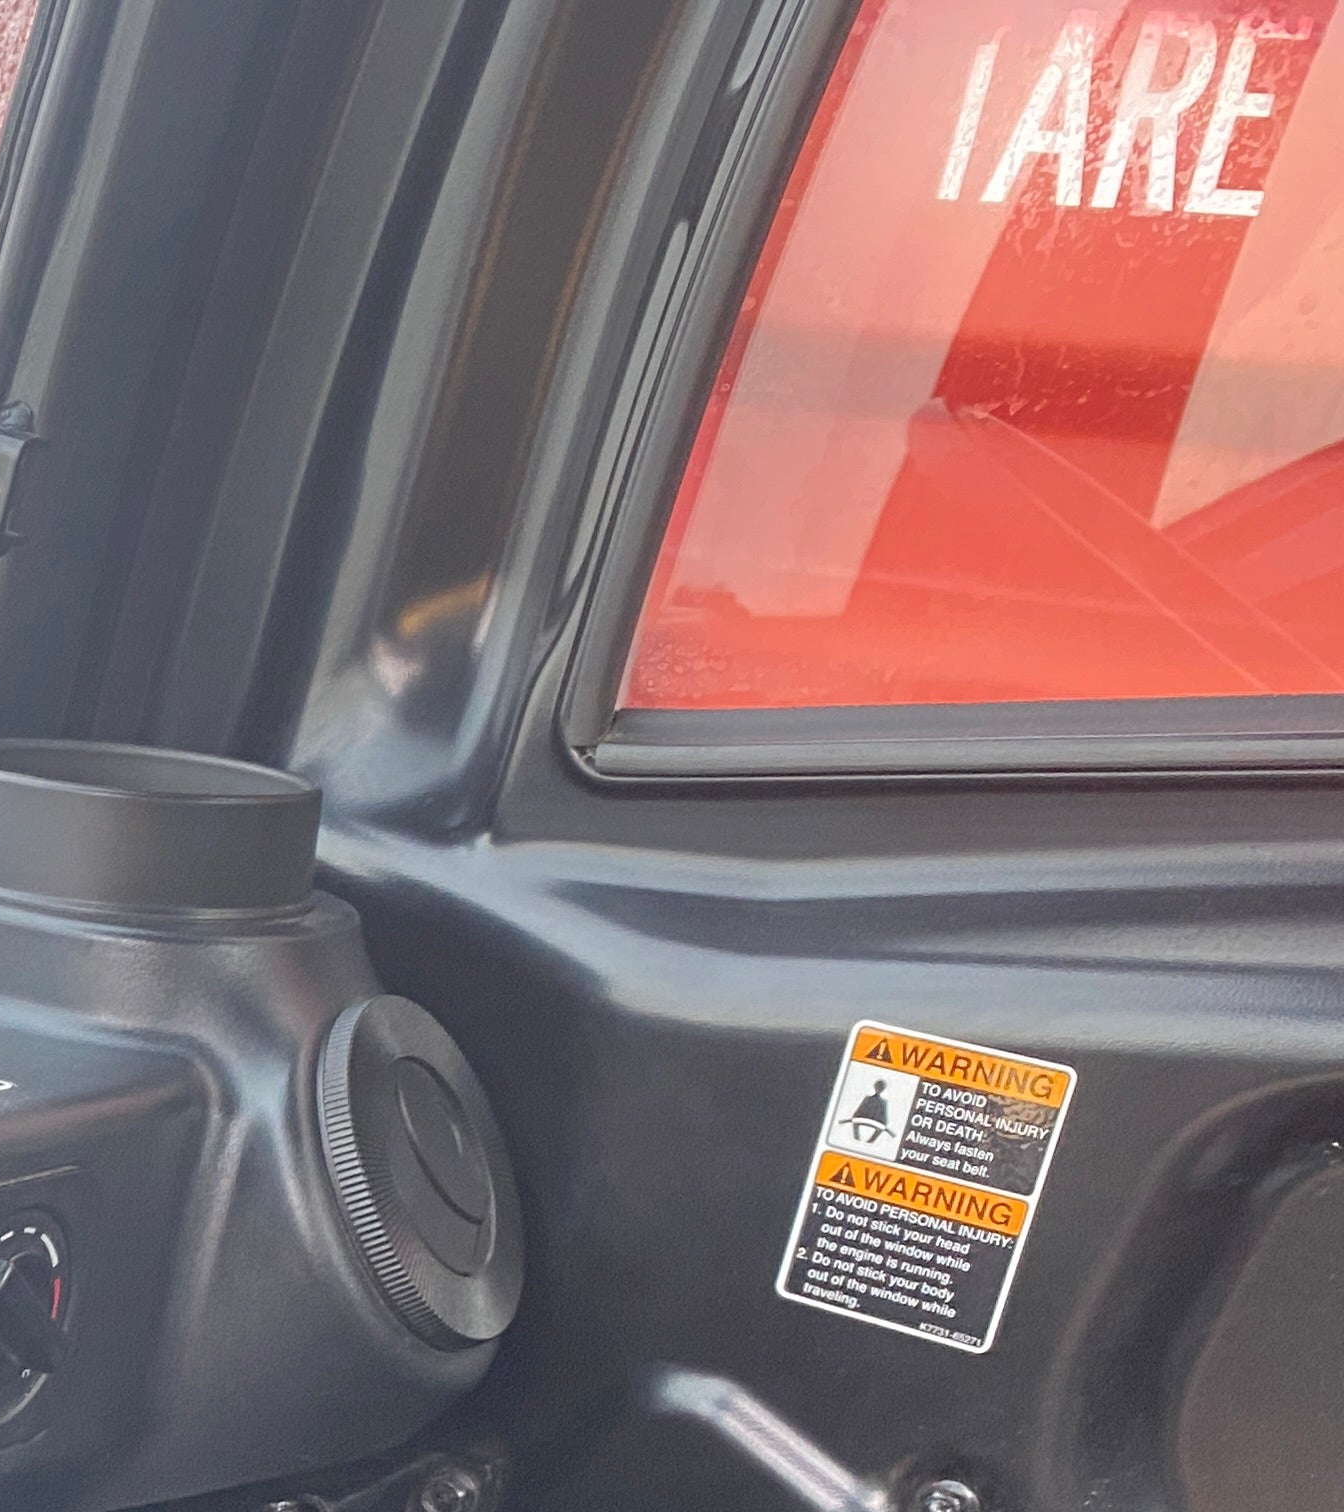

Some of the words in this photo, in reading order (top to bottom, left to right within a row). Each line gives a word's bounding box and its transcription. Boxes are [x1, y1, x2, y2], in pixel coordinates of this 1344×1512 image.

[899, 1041, 1054, 1100] WARNING
[919, 1082, 941, 1097] TO
[942, 1087, 987, 1108] AVOID
[910, 1114, 933, 1129] OR
[915, 1098, 993, 1127] PERSONAL
[994, 1117, 1049, 1140] INJURY
[899, 1147, 929, 1165] your
[931, 1154, 960, 1170] seat
[961, 1161, 991, 1178] belt.
[905, 1130, 952, 1152] Always
[952, 1142, 995, 1162] fasten
[815, 1186, 834, 1201] TO
[835, 1191, 878, 1213] AVOID
[879, 1203, 956, 1234] PERSONAL
[957, 1224, 1014, 1250] INJURY:
[862, 1167, 1012, 1227] WARNING
[810, 1202, 823, 1215] 1.
[824, 1205, 845, 1220] Do
[846, 1212, 868, 1227] not
[869, 1217, 901, 1236] stick
[903, 1228, 932, 1248] your
[935, 1235, 970, 1254] head
[819, 1221, 842, 1236] out
[843, 1227, 859, 1241] of
[860, 1232, 882, 1247] the
[883, 1238, 933, 1262] window
[934, 1252, 971, 1272] while
[811, 1251, 831, 1267] Do
[832, 1258, 855, 1273] not
[855, 1263, 887, 1283] stick
[888, 1275, 918, 1295] your
[919, 1282, 955, 1305] body
[815, 1236, 838, 1252] the
[838, 1243, 884, 1268] engine
[885, 1256, 898, 1269] is
[899, 1259, 955, 1287] running.
[801, 1281, 861, 1309] traveling.
[806, 1266, 828, 1282] out
[829, 1272, 845, 1287] of
[846, 1278, 868, 1293] the
[869, 1284, 919, 1308] window
[920, 1299, 956, 1319] while
